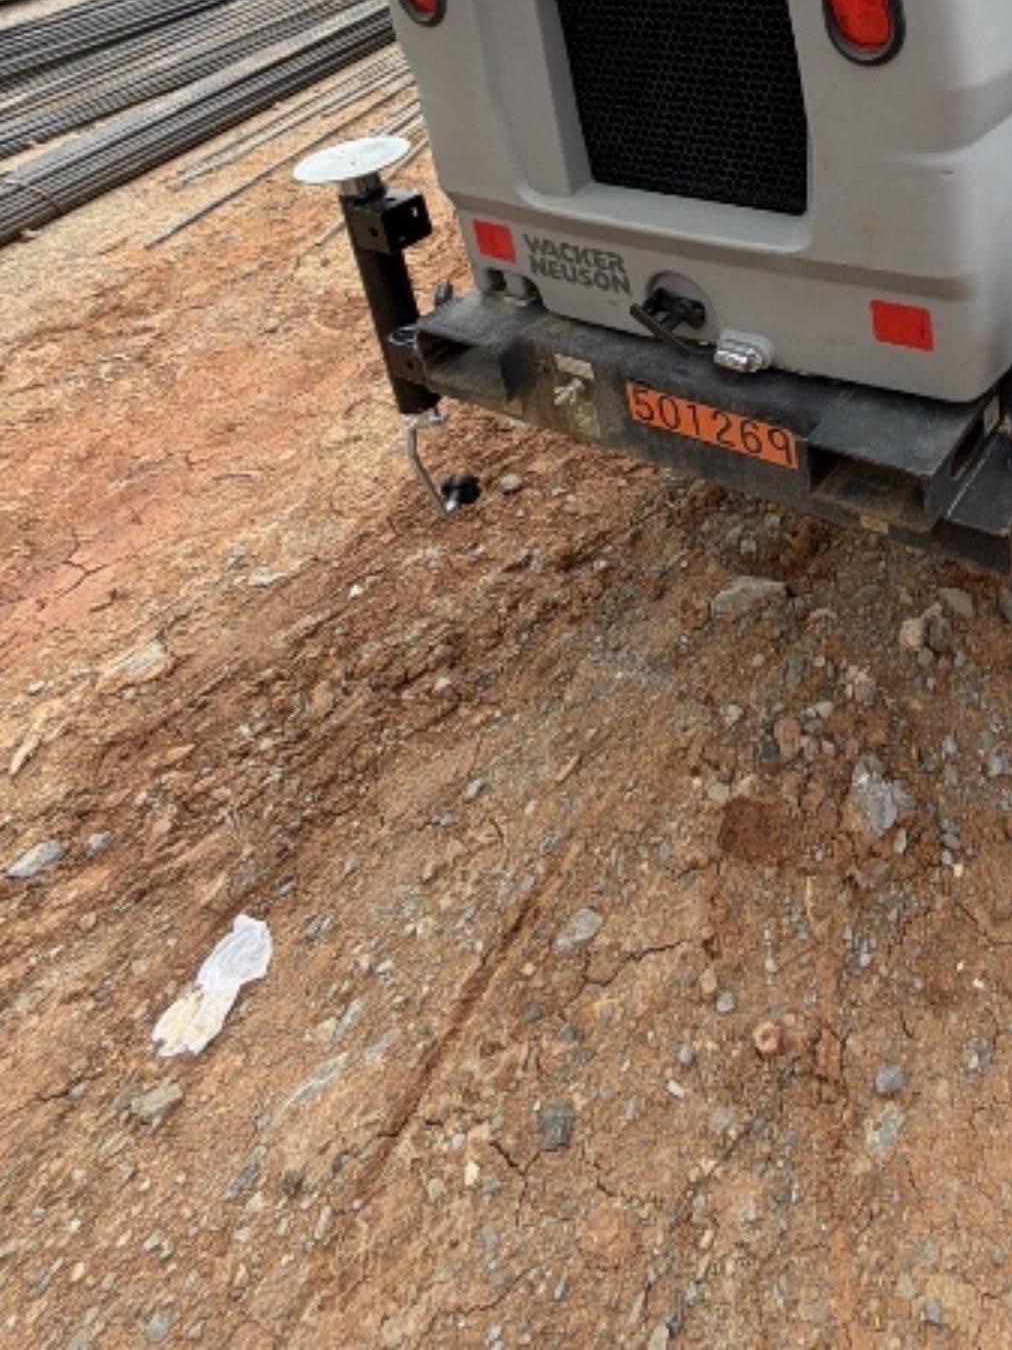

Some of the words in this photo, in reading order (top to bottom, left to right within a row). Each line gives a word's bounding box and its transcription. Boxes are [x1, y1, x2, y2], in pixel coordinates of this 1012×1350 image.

[521, 233, 627, 276] WACKER
[528, 254, 635, 297] NEUSON
[632, 385, 795, 467] 501269
